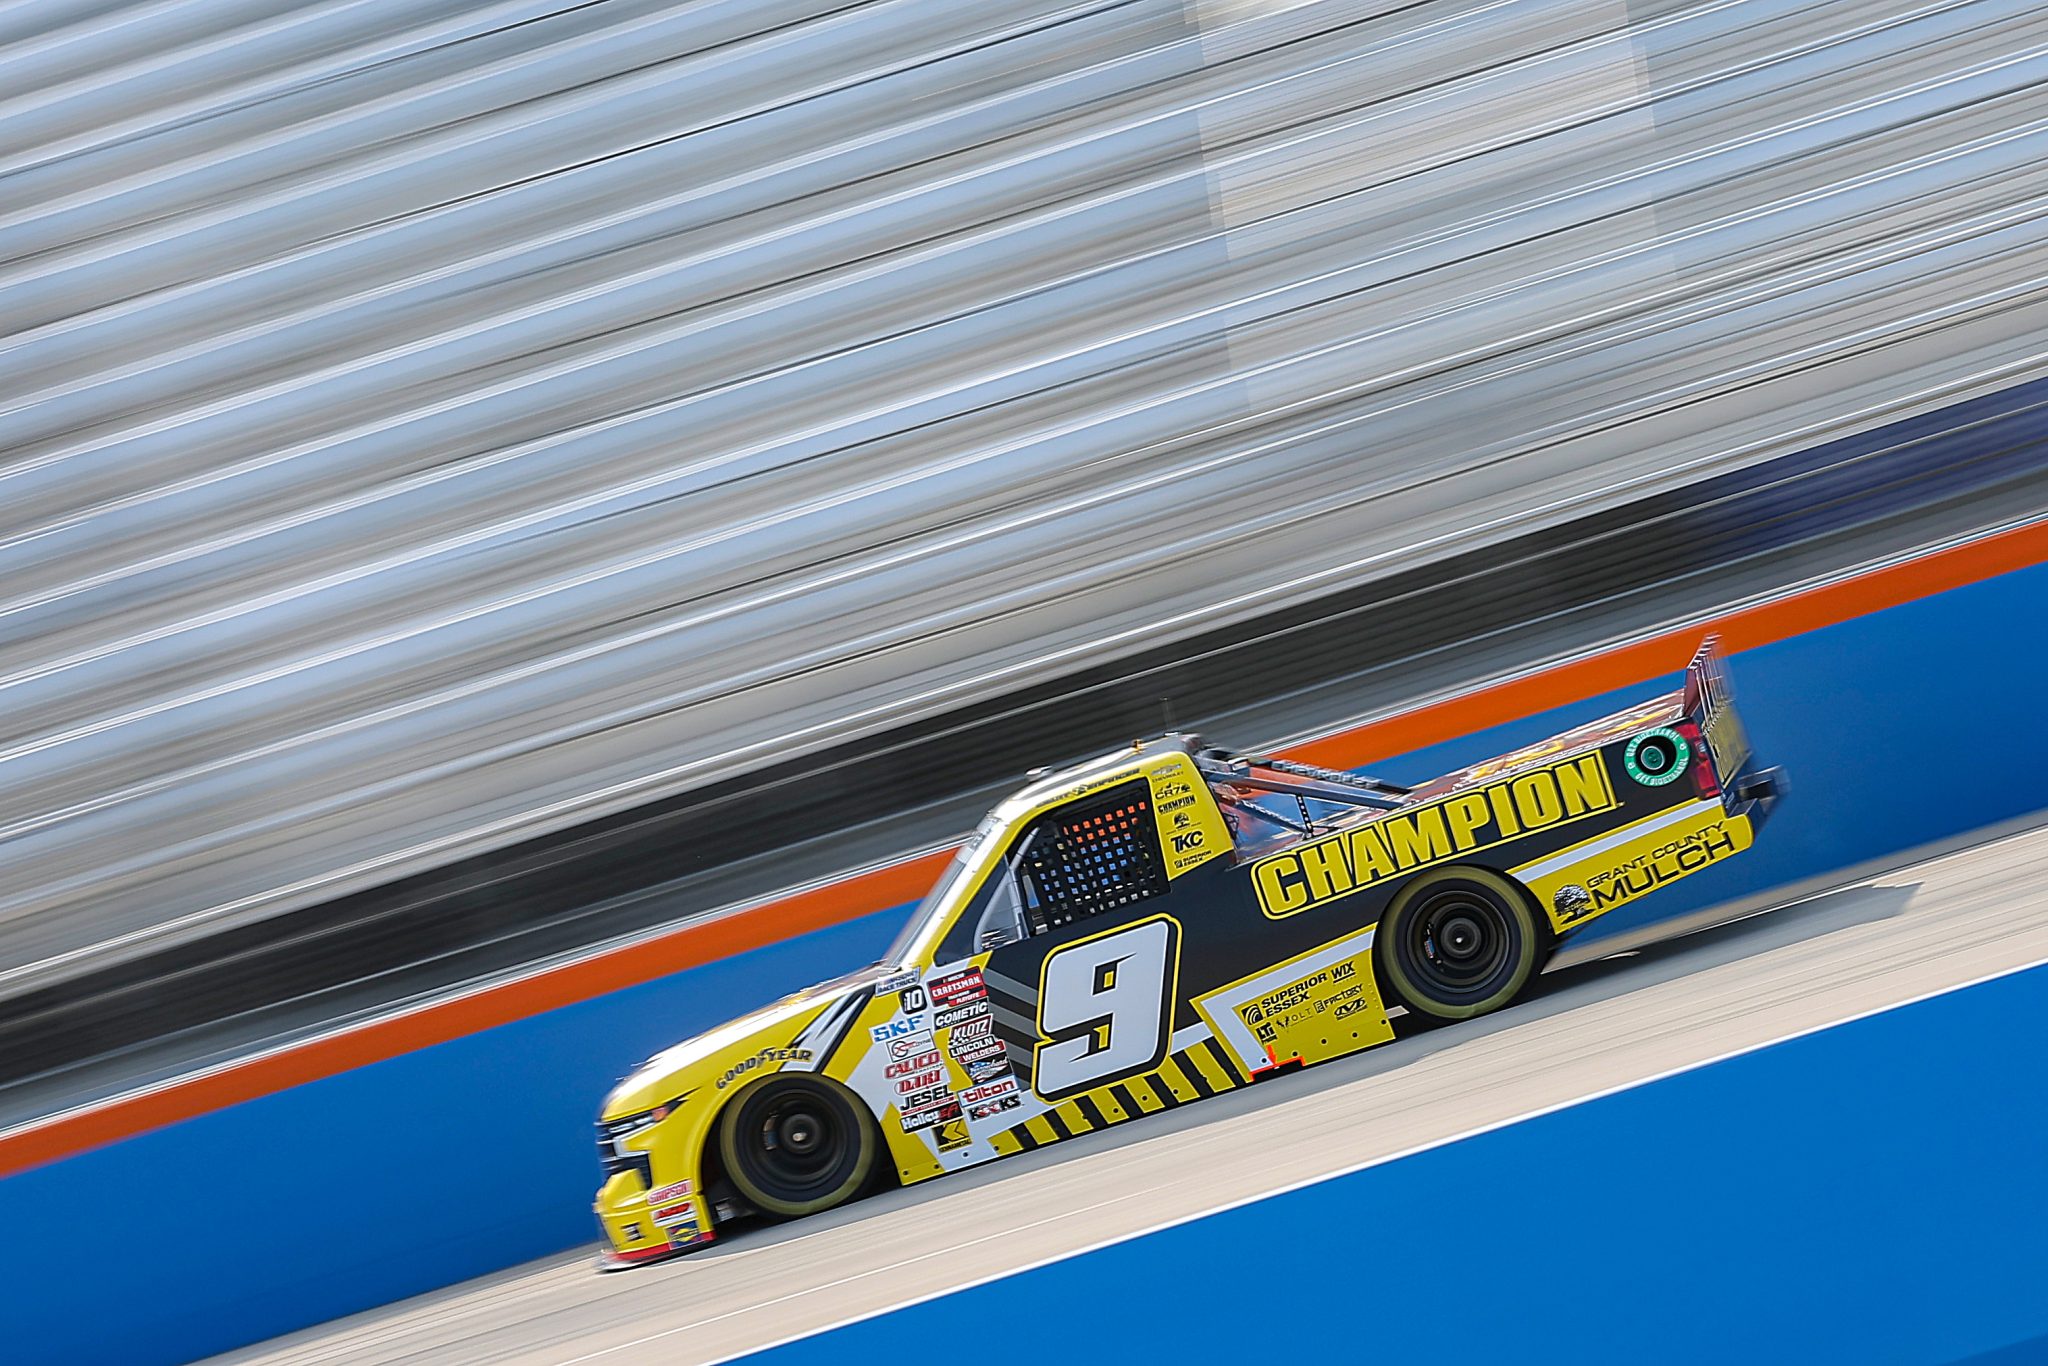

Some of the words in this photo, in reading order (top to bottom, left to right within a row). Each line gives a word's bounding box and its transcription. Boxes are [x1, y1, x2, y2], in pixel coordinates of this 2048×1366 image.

[1158, 795, 1196, 813] CHAMPION
[1170, 830, 1204, 854] TKC
[1258, 755, 1611, 915] CHAMPION
[1586, 854, 1648, 889] GRANT
[1651, 820, 1724, 860] COUNTY
[1591, 831, 1736, 910] MULCH
[1330, 961, 1356, 980] WIX
[931, 974, 981, 997] CRAFTSMAN
[1261, 972, 1329, 1009] SUPERIOR
[905, 989, 922, 1012] 10
[1036, 919, 1172, 1097] 9
[1265, 991, 1311, 1018] ESSEX
[935, 1001, 989, 1027] COMETIC
[1276, 1008, 1312, 1028] VOLT
[873, 1015, 924, 1042] SKF
[953, 1019, 989, 1038] KLOTZ
[950, 1036, 995, 1057] LINCOLN
[962, 1044, 1001, 1063] WELDERS
[716, 1046, 812, 1090] GOODYEAR
[884, 1051, 942, 1079] CALICO
[901, 1084, 954, 1111] JESEL
[962, 1079, 1015, 1103] tilton
